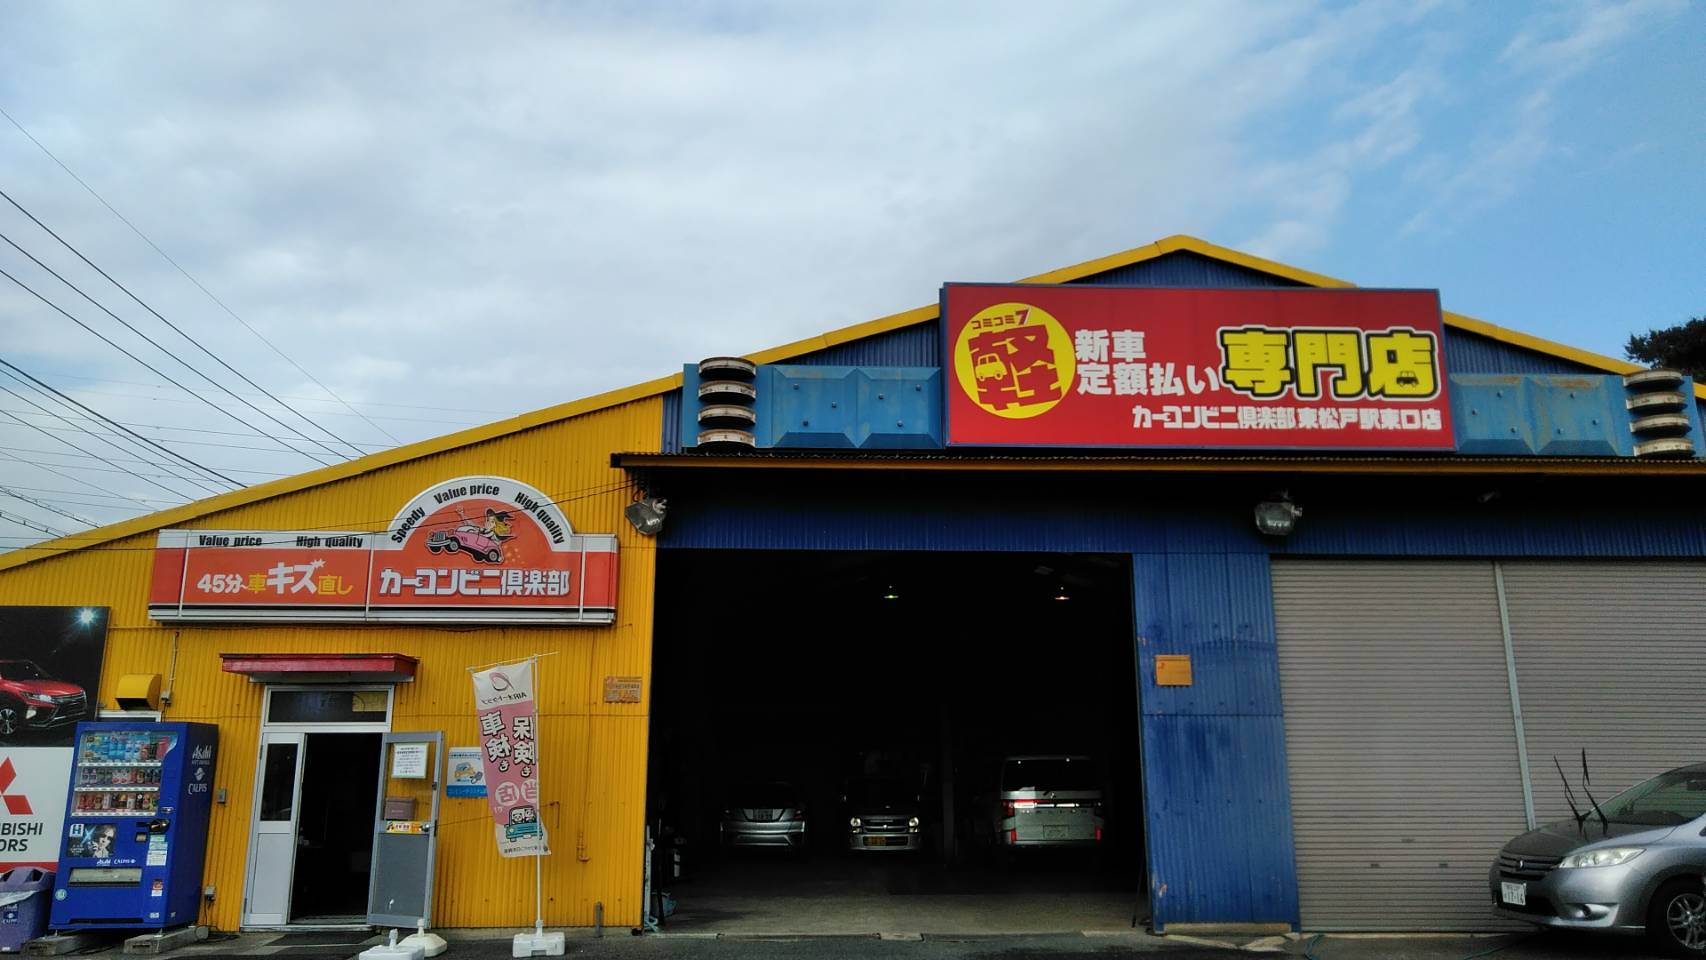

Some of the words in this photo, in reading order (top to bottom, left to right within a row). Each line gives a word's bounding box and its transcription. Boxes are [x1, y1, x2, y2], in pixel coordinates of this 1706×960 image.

[971, 304, 1031, 329] コミコミ7
[1075, 329, 1146, 362] 新車
[1218, 325, 1440, 400] 専門店
[1076, 362, 1220, 396] 定額払い
[391, 506, 426, 544] Speedy
[433, 487, 467, 505] Value
[469, 484, 500, 497] price
[514, 491, 540, 512] High
[537, 507, 566, 545] quality
[199, 535, 229, 546] Value
[234, 536, 262, 547] price
[296, 536, 321, 547] High
[325, 536, 363, 548] quality
[379, 569, 571, 597] カーコンビニ倶楽部
[192, 744, 212, 759] Asahi
[187, 783, 208, 795] CALPIS
[0, 822, 43, 836] BISHI
